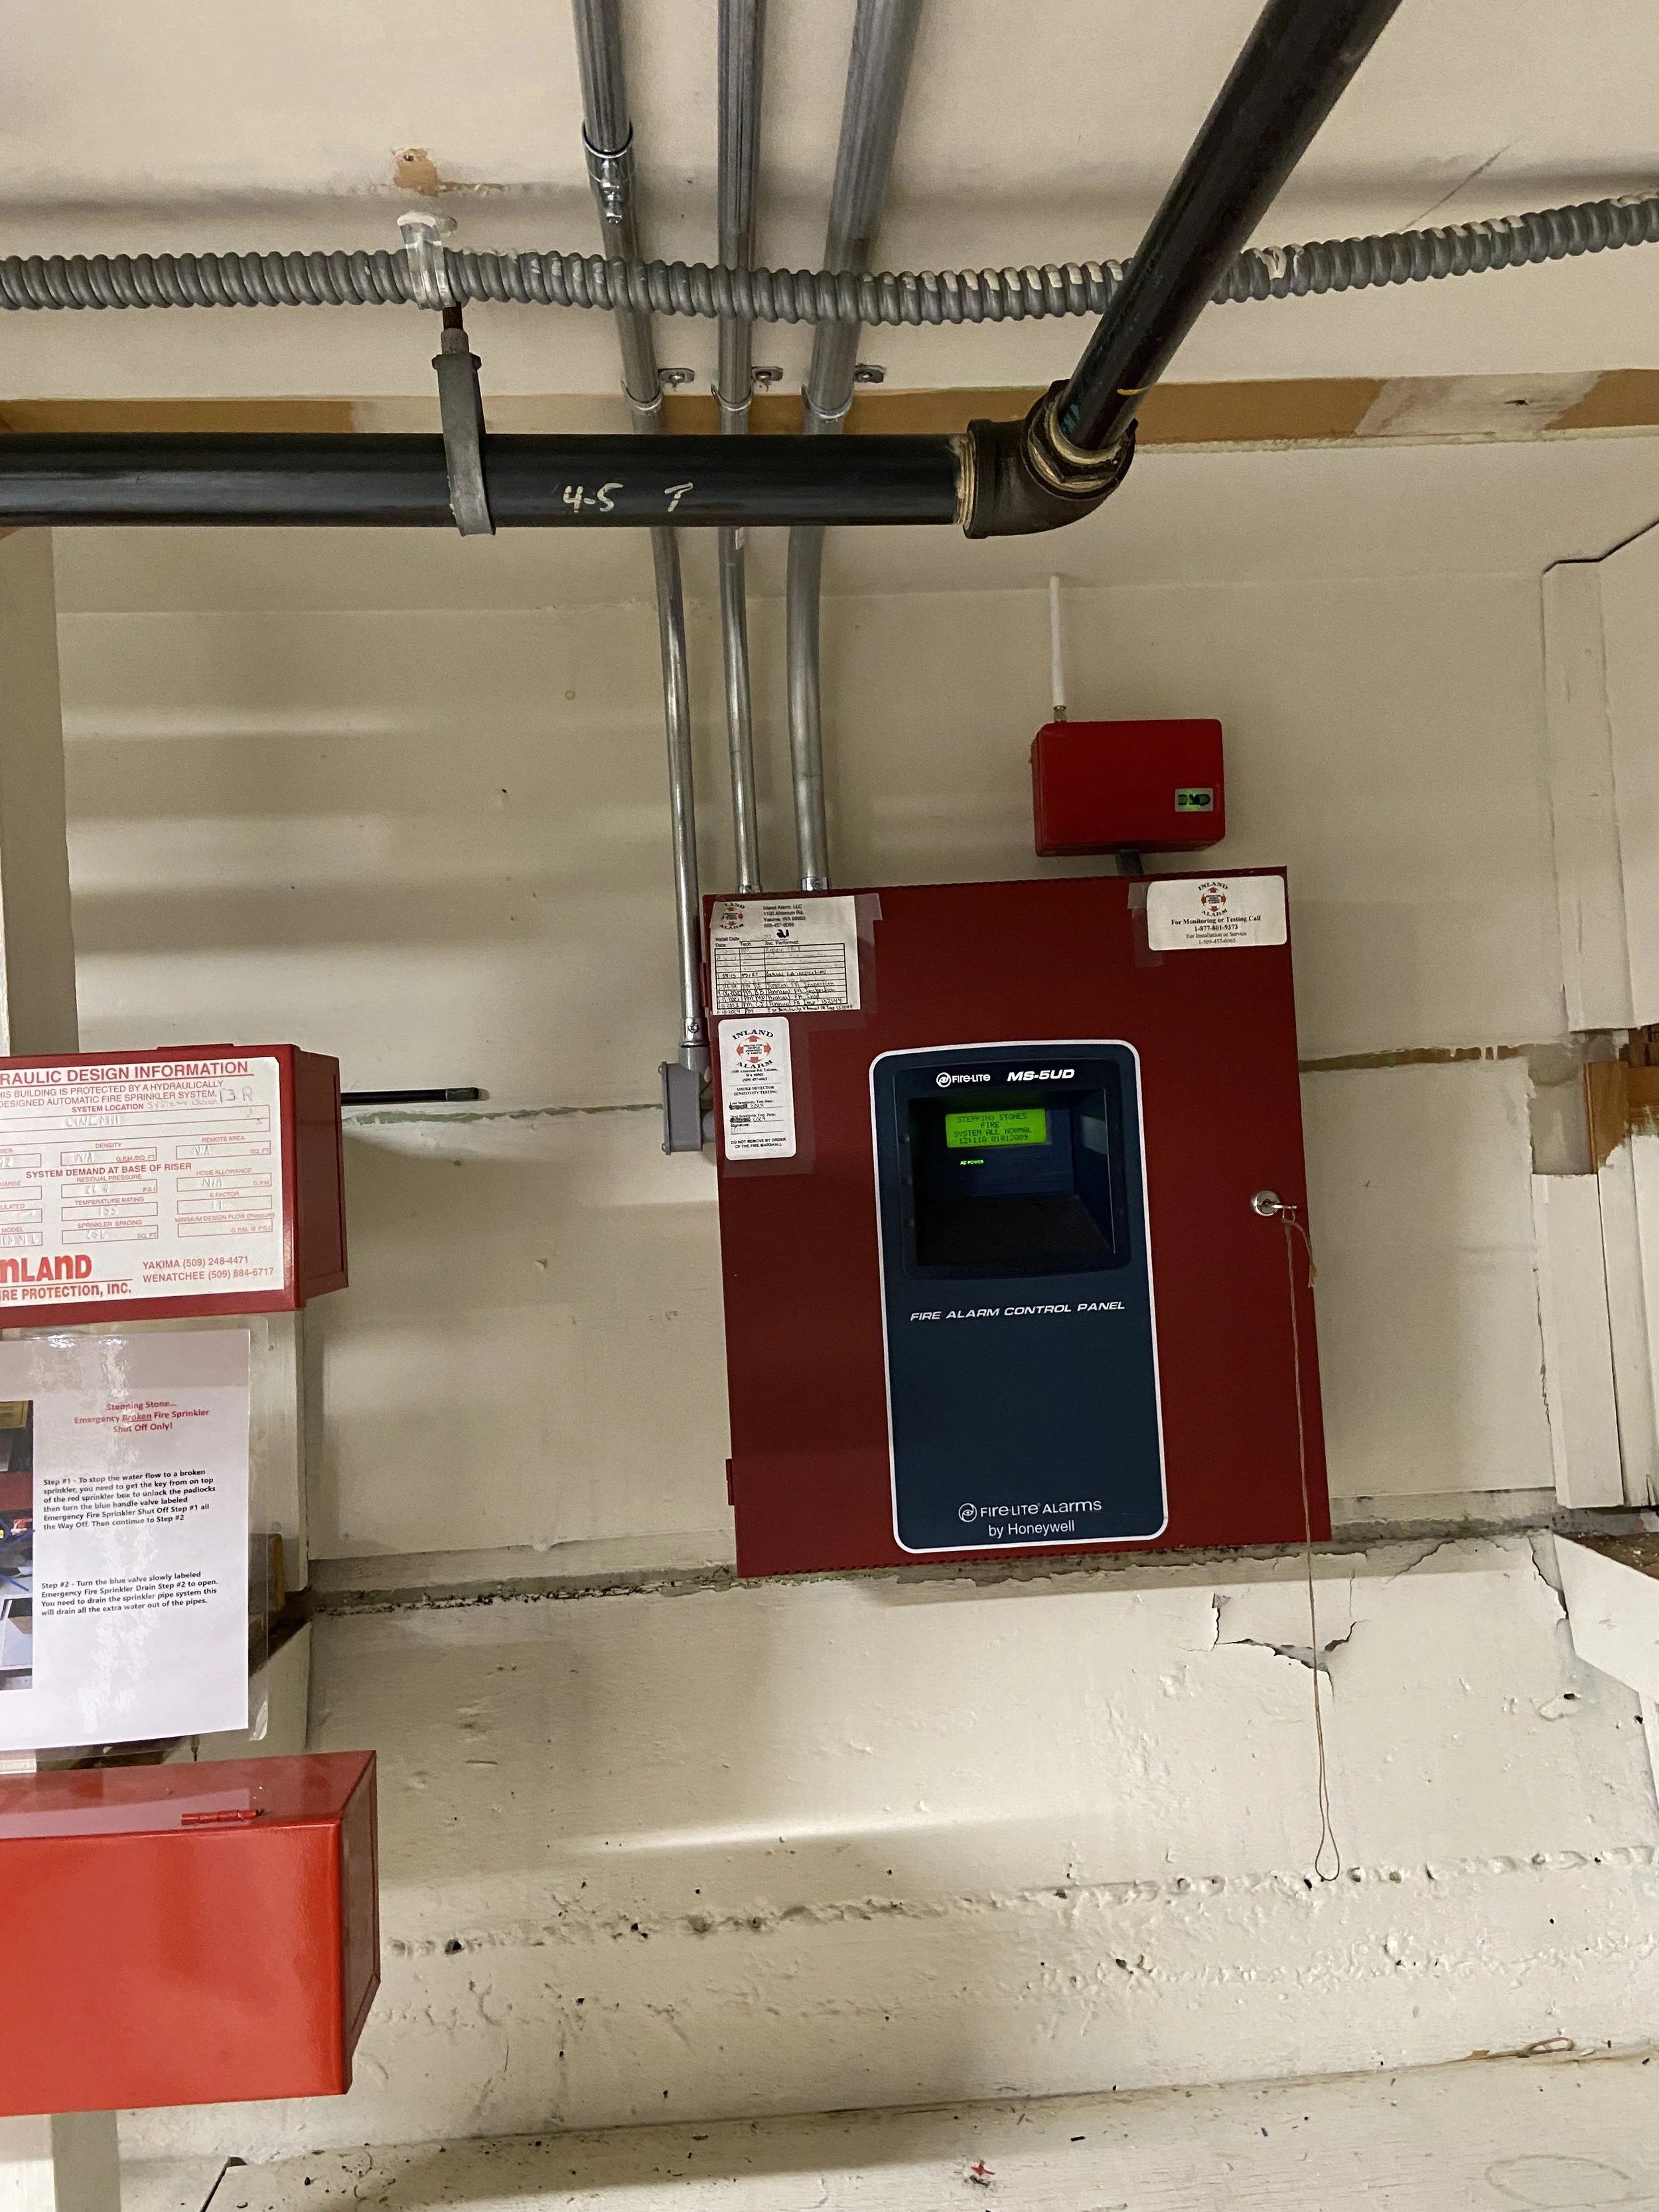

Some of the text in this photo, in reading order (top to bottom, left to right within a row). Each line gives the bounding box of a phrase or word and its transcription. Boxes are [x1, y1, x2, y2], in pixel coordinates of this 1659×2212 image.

[1198, 882, 1228, 891] INLAND
[732, 1029, 773, 1040] INLAND
[737, 1060, 773, 1069] ALARM
[0, 1061, 248, 1085] RAULIC DESIGN INFORMATION
[1007, 1069, 1074, 1081] MS-5UD
[15, 1089, 56, 1098] BUILDING
[71, 1085, 125, 1094] PROTECTED
[151, 1080, 223, 1090] HYDRAULICALLY
[47, 1096, 99, 1105] AUTOMATIC
[125, 1092, 175, 1101] SPRINKLER
[179, 1090, 217, 1098] SYSTEM.
[27, 1170, 62, 1179] SYSTEM
[66, 1167, 105, 1176] DEMAND
[183, 1258, 206, 1268] (509)
[208, 1256, 248, 1265] 248-4471
[143, 1268, 274, 1283] WENATCHEE (509) 884-6717
[910, 1301, 1125, 1321] FIRE ALARM CONTROL PANEL
[74, 1416, 119, 1424] Emergency
[989, 1520, 1074, 1539] by Honeywell
